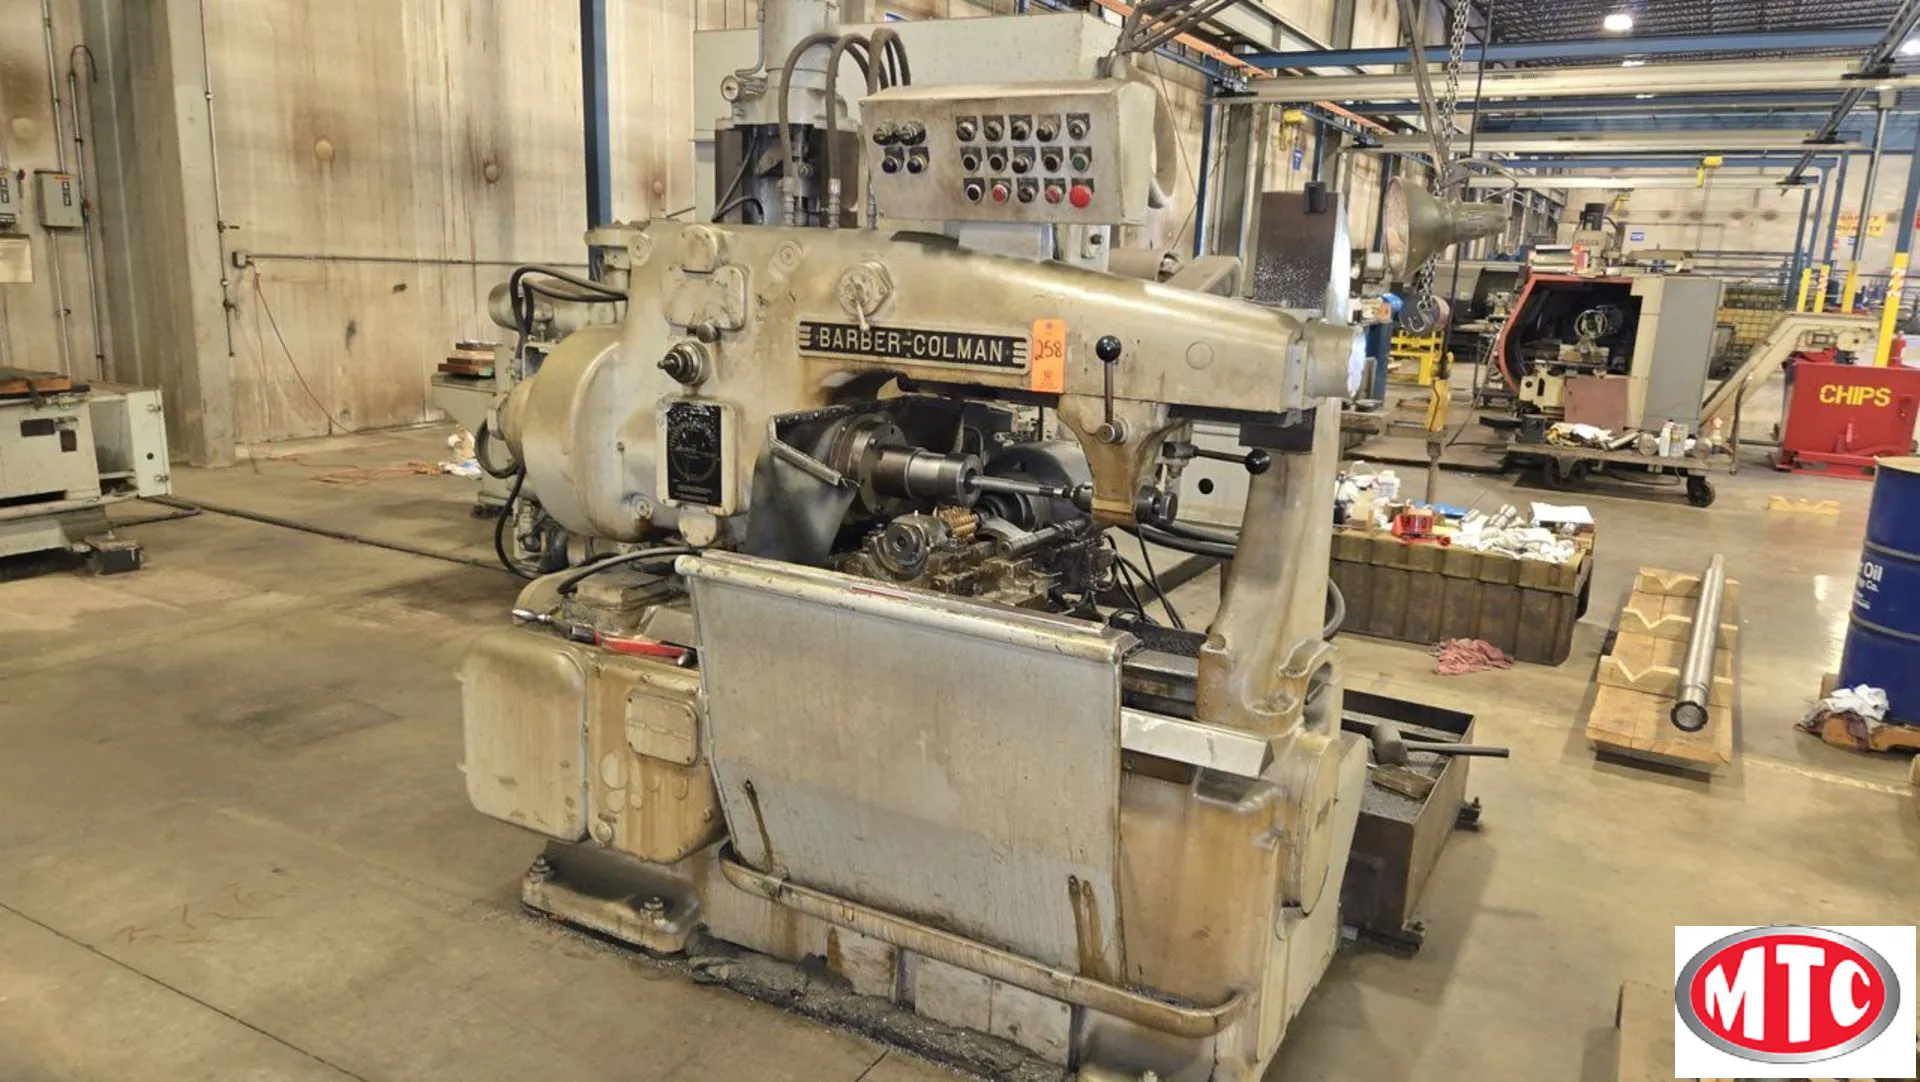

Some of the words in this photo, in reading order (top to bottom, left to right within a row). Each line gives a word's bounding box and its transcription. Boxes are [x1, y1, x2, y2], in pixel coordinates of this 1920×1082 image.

[819, 326, 1003, 362] BARBER-COLMAN
[1035, 339, 1062, 360] 258
[1819, 384, 1892, 407] CHIPS
[1864, 561, 1883, 582] Oil
